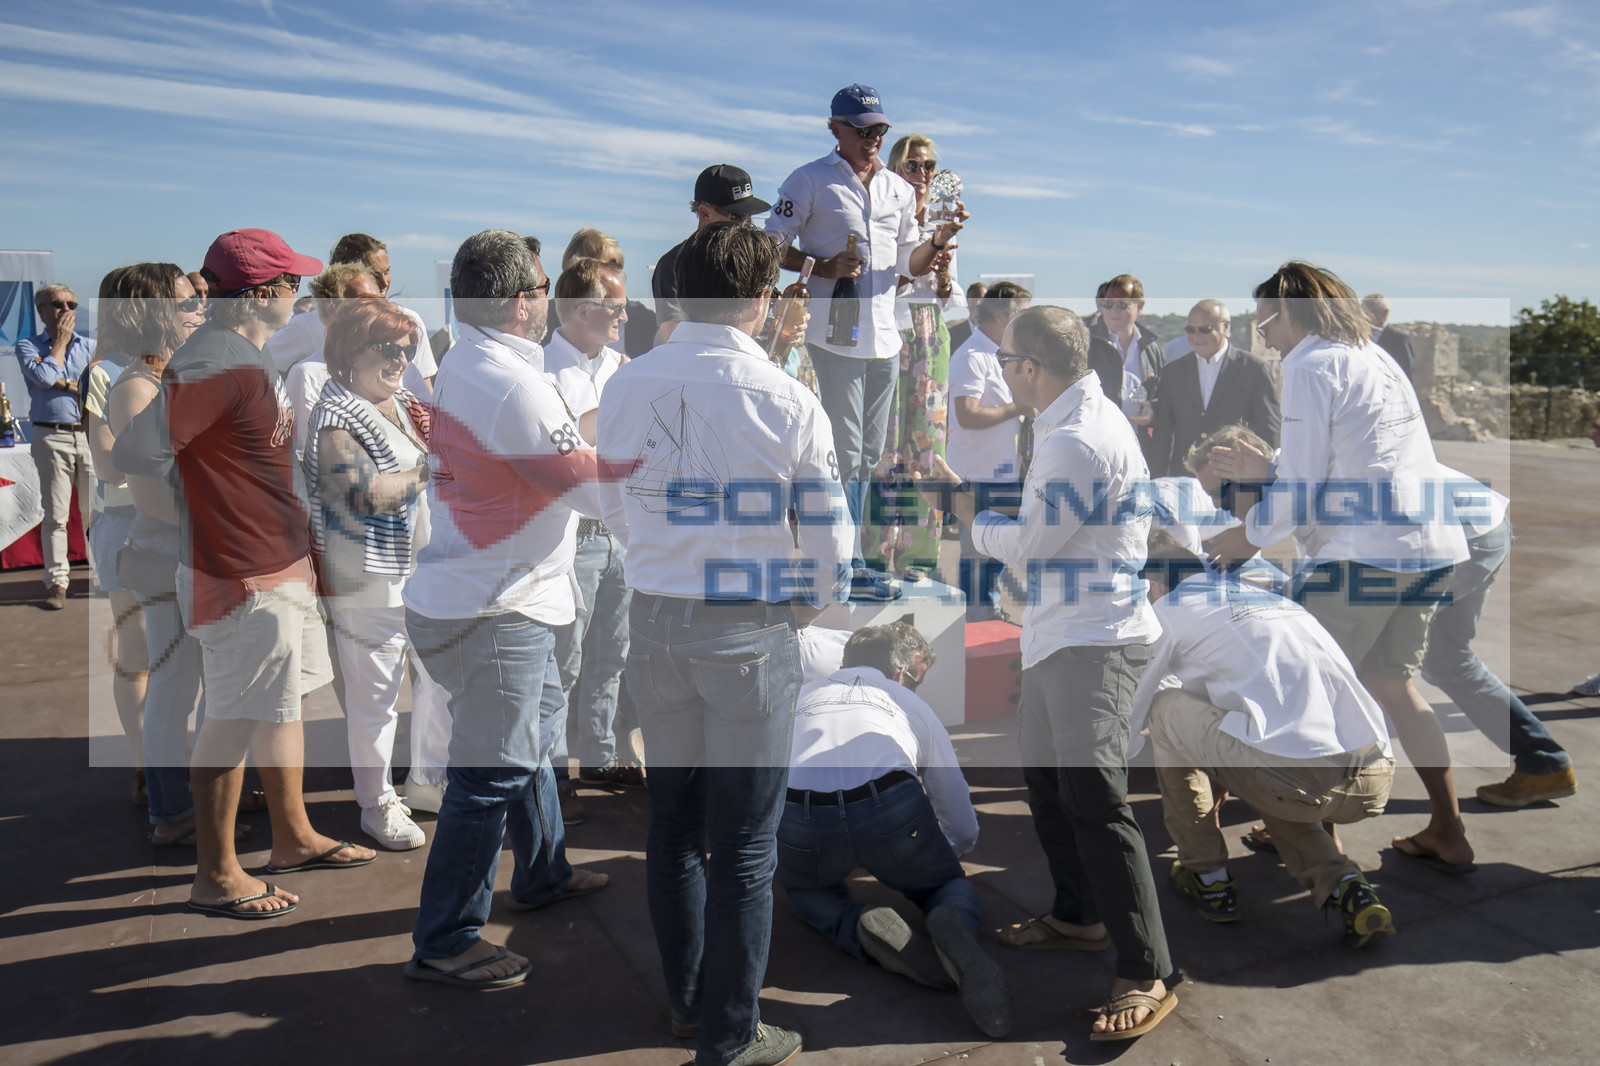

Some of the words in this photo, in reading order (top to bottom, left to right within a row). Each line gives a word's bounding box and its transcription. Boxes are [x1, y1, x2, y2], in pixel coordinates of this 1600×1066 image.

[774, 198, 794, 218] 88
[549, 422, 581, 456] 88
[646, 438, 657, 449] 88
